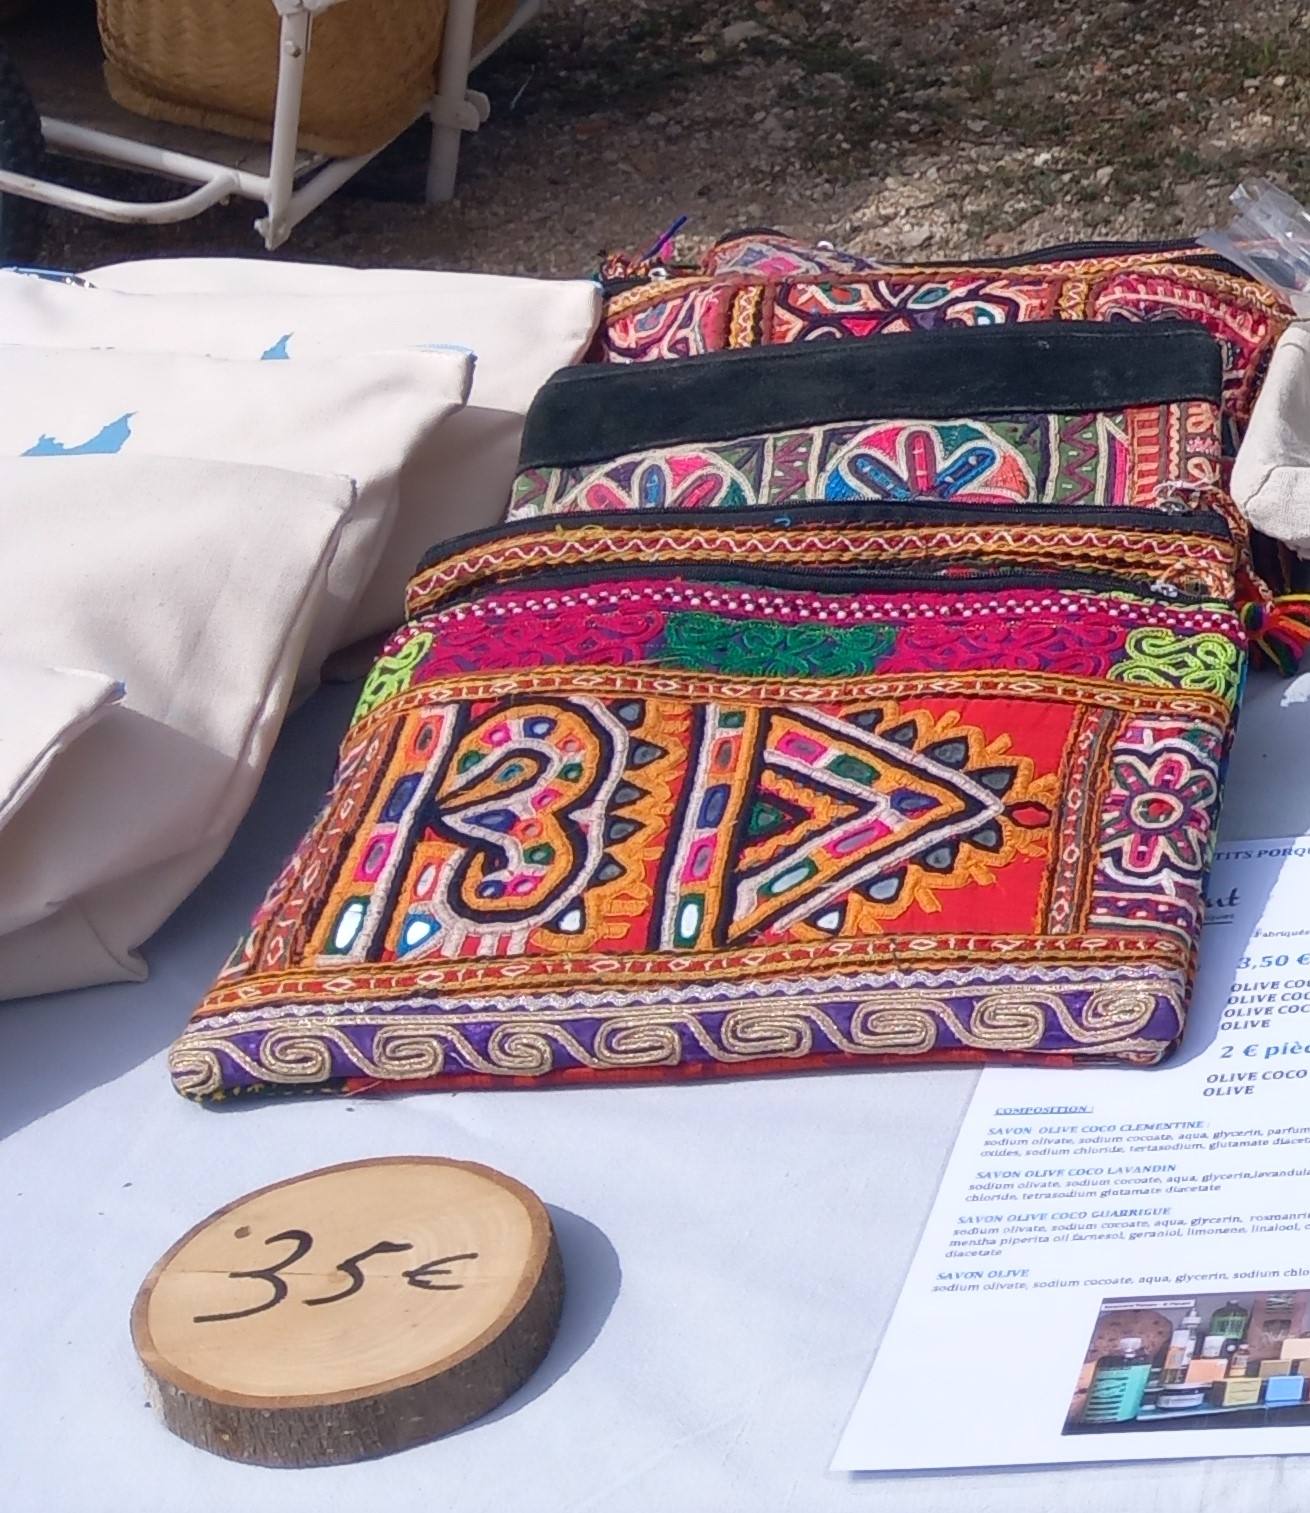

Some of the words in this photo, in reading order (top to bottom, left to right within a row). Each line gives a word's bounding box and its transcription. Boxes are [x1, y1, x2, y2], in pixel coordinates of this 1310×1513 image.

[1214, 849, 1252, 861] TITS
[1237, 954, 1290, 970] 3,50
[1229, 980, 1280, 993] OLIVE
[1227, 992, 1276, 1005] OLIVE
[1223, 1005, 1273, 1018] OLIVE
[1220, 1019, 1272, 1031] OLIVE
[1219, 1045, 1235, 1059] 2
[1243, 1044, 1260, 1057] €
[1206, 1071, 1258, 1084] OLIVE
[1261, 1069, 1308, 1081] COCO
[1203, 1085, 1256, 1097] OLIVE
[987, 1127, 1033, 1135] SAVON
[1038, 1125, 1079, 1134] OLIVE
[1081, 1124, 1117, 1133] COCO
[1119, 1121, 1205, 1132] CLEMENTINE
[983, 1136, 1028, 1146] sodium
[1079, 1133, 1123, 1144] sodium
[1025, 1146, 1070, 1157] sodium
[975, 1170, 1021, 1180] SAVON
[1024, 1168, 1065, 1178] OLIVE
[1068, 1166, 1105, 1177] COCO
[1107, 1163, 1177, 1174] LAVANDIN
[968, 1179, 1015, 1191] sodium
[1064, 1176, 1110, 1187] sodium
[957, 1214, 1003, 1225] SAVON
[1006, 1212, 1049, 1222] OLIVE
[1051, 1210, 1088, 1220] COCO
[952, 1224, 999, 1235] sodium
[1051, 1221, 1097, 1232] sodium
[931, 1280, 980, 1292] sodium
[1032, 1276, 1080, 1288] sodium
[1233, 1268, 1280, 1280] sodium
[936, 1270, 984, 1280] SAVON
[987, 1268, 1031, 1279] OLIVE
